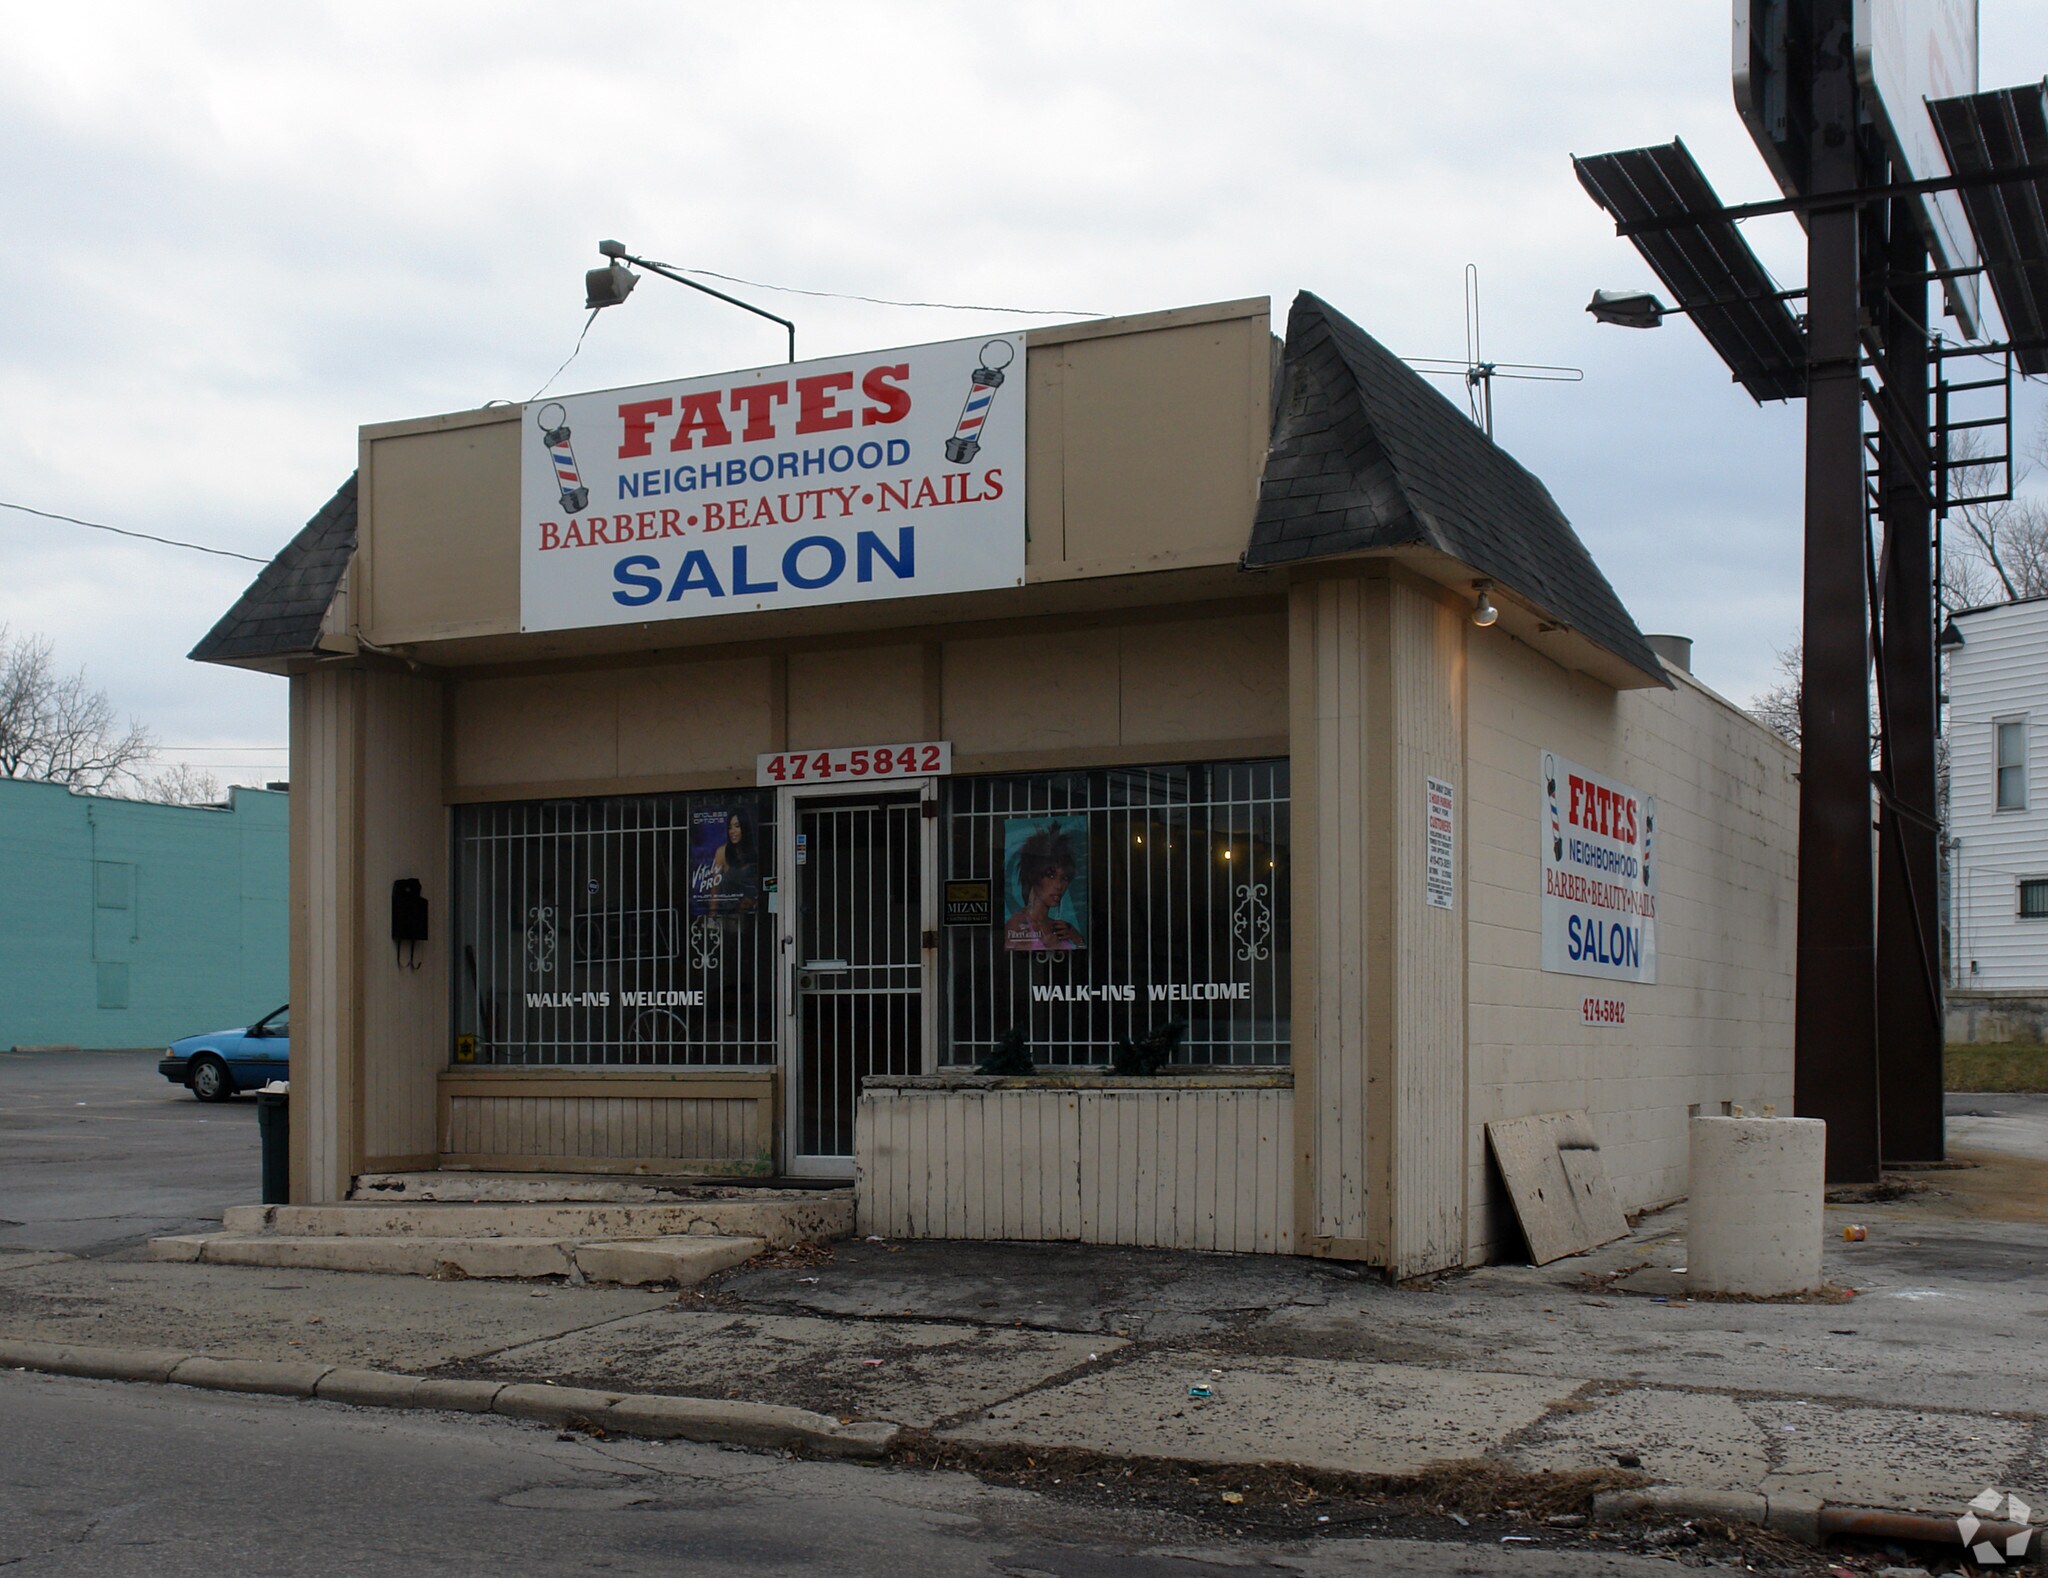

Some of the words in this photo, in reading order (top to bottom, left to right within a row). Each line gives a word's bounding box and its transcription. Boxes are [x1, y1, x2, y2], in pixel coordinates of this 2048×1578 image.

[618, 363, 911, 458] FATES
[618, 439, 910, 499] NEIGHBORHOOD
[539, 509, 686, 551] BARBER
[703, 485, 860, 533] BEAUTY
[877, 469, 1003, 513] NAILS
[612, 526, 915, 607] SALON
[767, 746, 940, 780] 474-5842
[1569, 774, 1637, 845] FATES
[1569, 838, 1638, 879] NEIGHBORHOOD
[699, 874, 722, 893] PRO
[947, 902, 988, 913] MIZANI
[1568, 914, 1639, 968] SALON
[526, 992, 610, 1008] WALK-INS
[621, 991, 704, 1007] WELCOME
[1033, 984, 1136, 1002] WALK-INS
[1147, 983, 1250, 1001] WELCOME
[1583, 998, 1625, 1023] 474-5842
